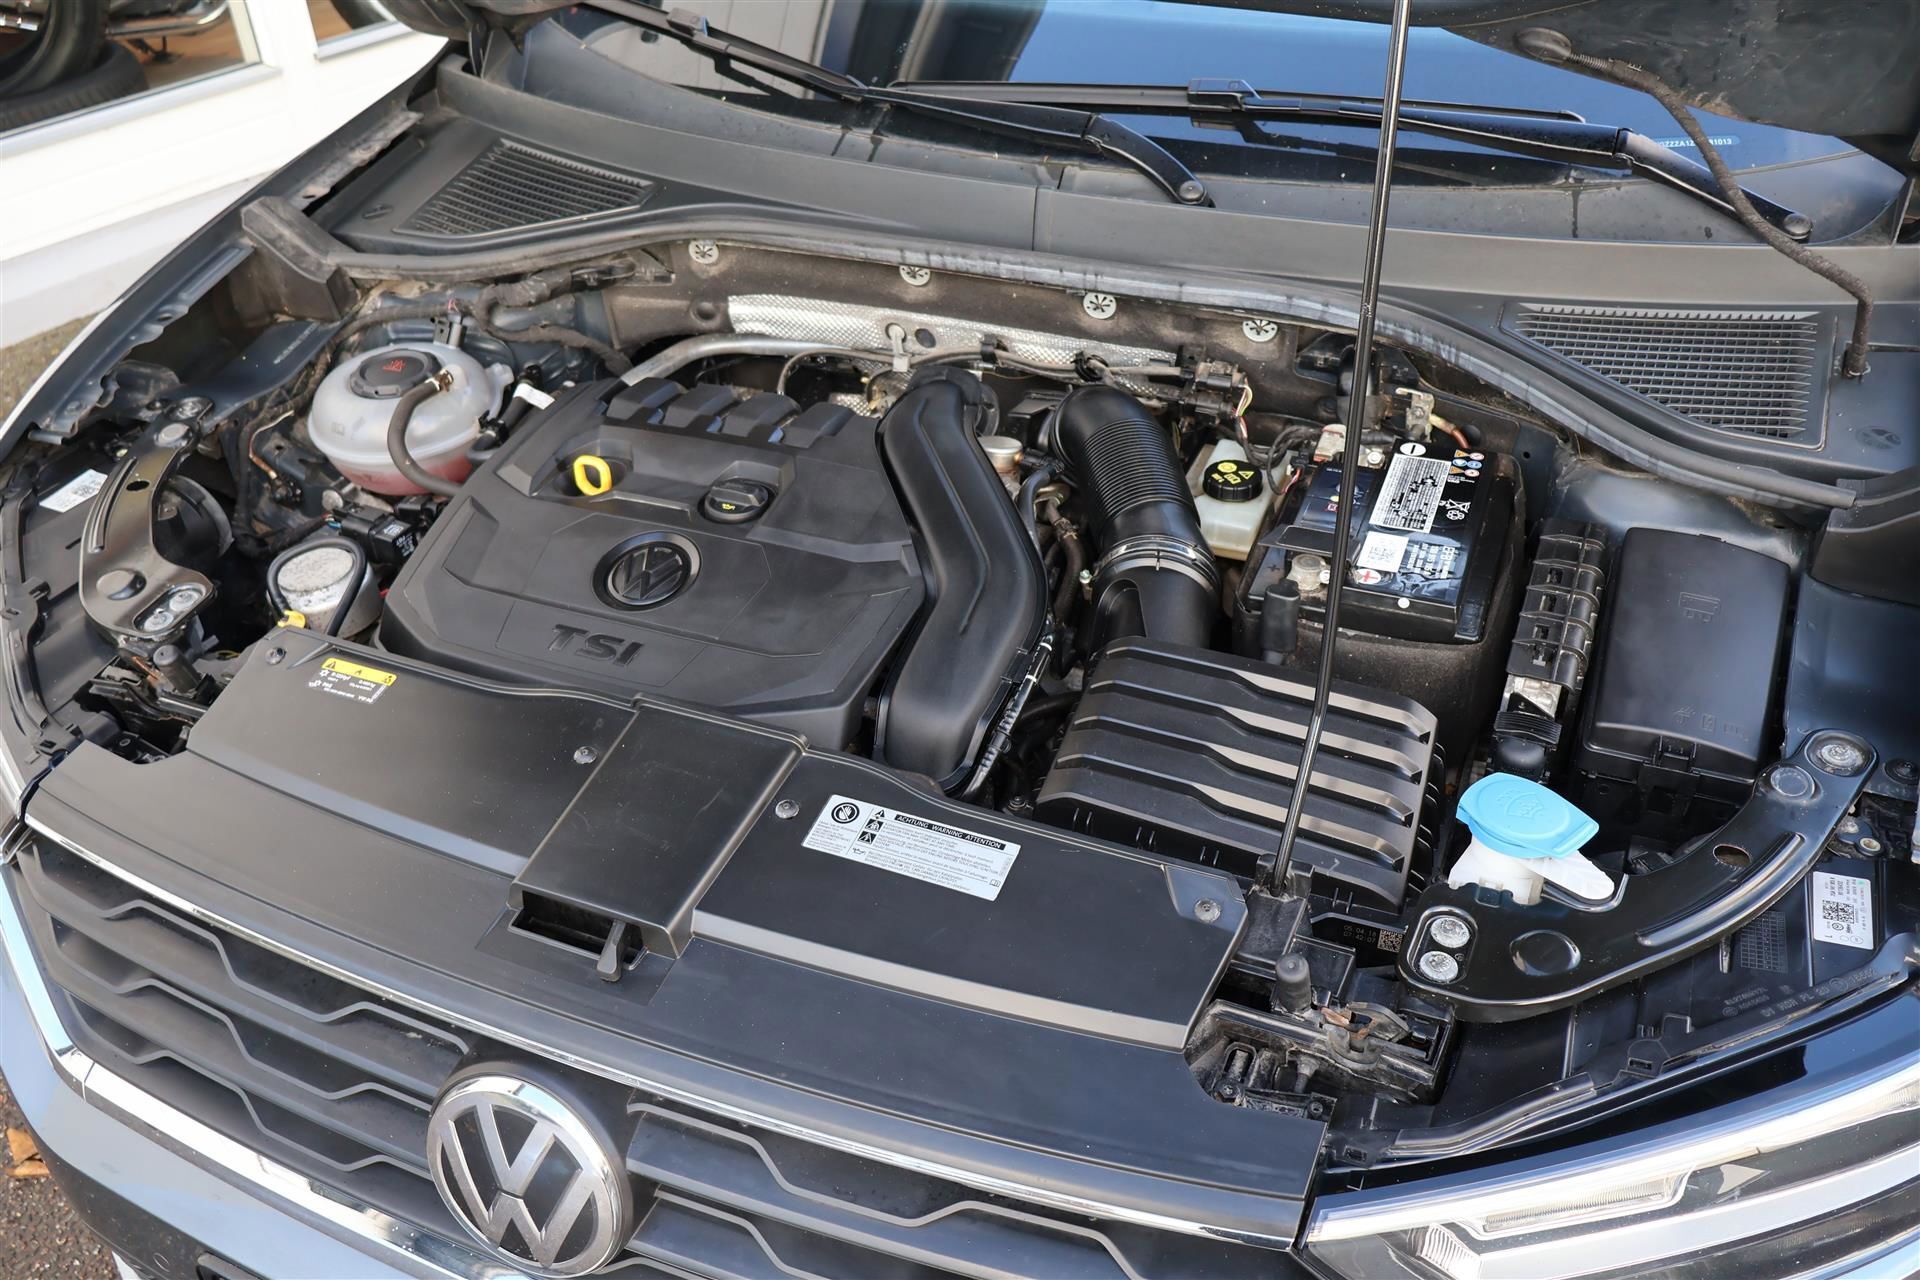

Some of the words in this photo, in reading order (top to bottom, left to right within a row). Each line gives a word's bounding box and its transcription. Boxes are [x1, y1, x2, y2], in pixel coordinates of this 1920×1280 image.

[548, 623, 645, 667] TSI
[897, 814, 929, 829] ACHTUNG
[931, 824, 963, 838] WARNING
[964, 835, 1001, 849] ATTENTION
